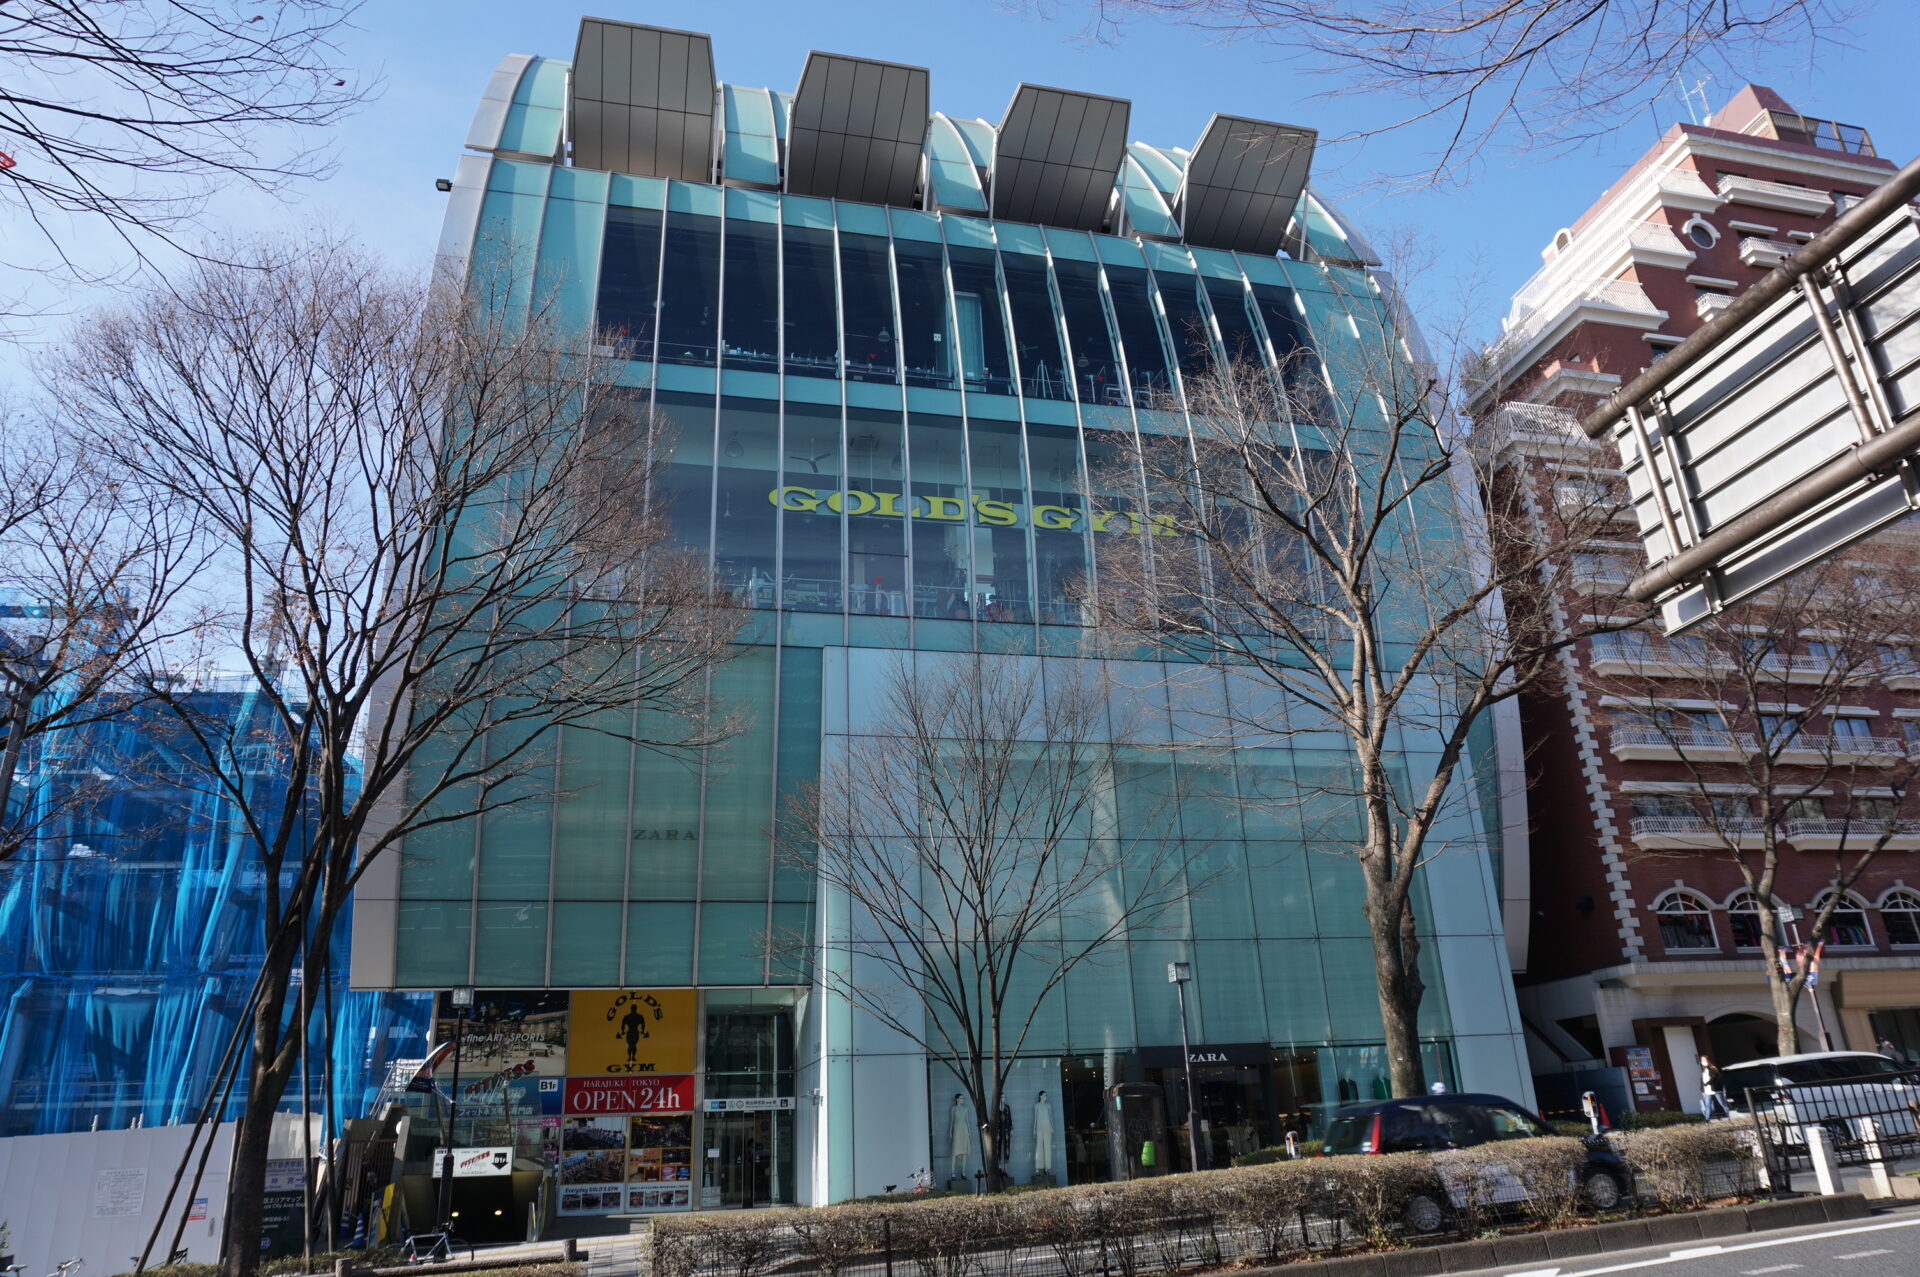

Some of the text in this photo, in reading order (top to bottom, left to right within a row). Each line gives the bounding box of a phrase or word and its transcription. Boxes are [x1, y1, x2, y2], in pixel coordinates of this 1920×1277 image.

[768, 485, 1181, 537] GOLD'S GYM
[632, 829, 697, 840] ZARA
[606, 991, 663, 1021] GOLD'S
[509, 1032, 546, 1042] SPORTS
[1189, 1053, 1229, 1062] ZARA
[606, 1063, 656, 1072] GYM
[540, 1081, 557, 1090] B1F
[583, 1079, 660, 1088] HARAJUKU TOKYO
[573, 1086, 681, 1112] OPEN 24h
